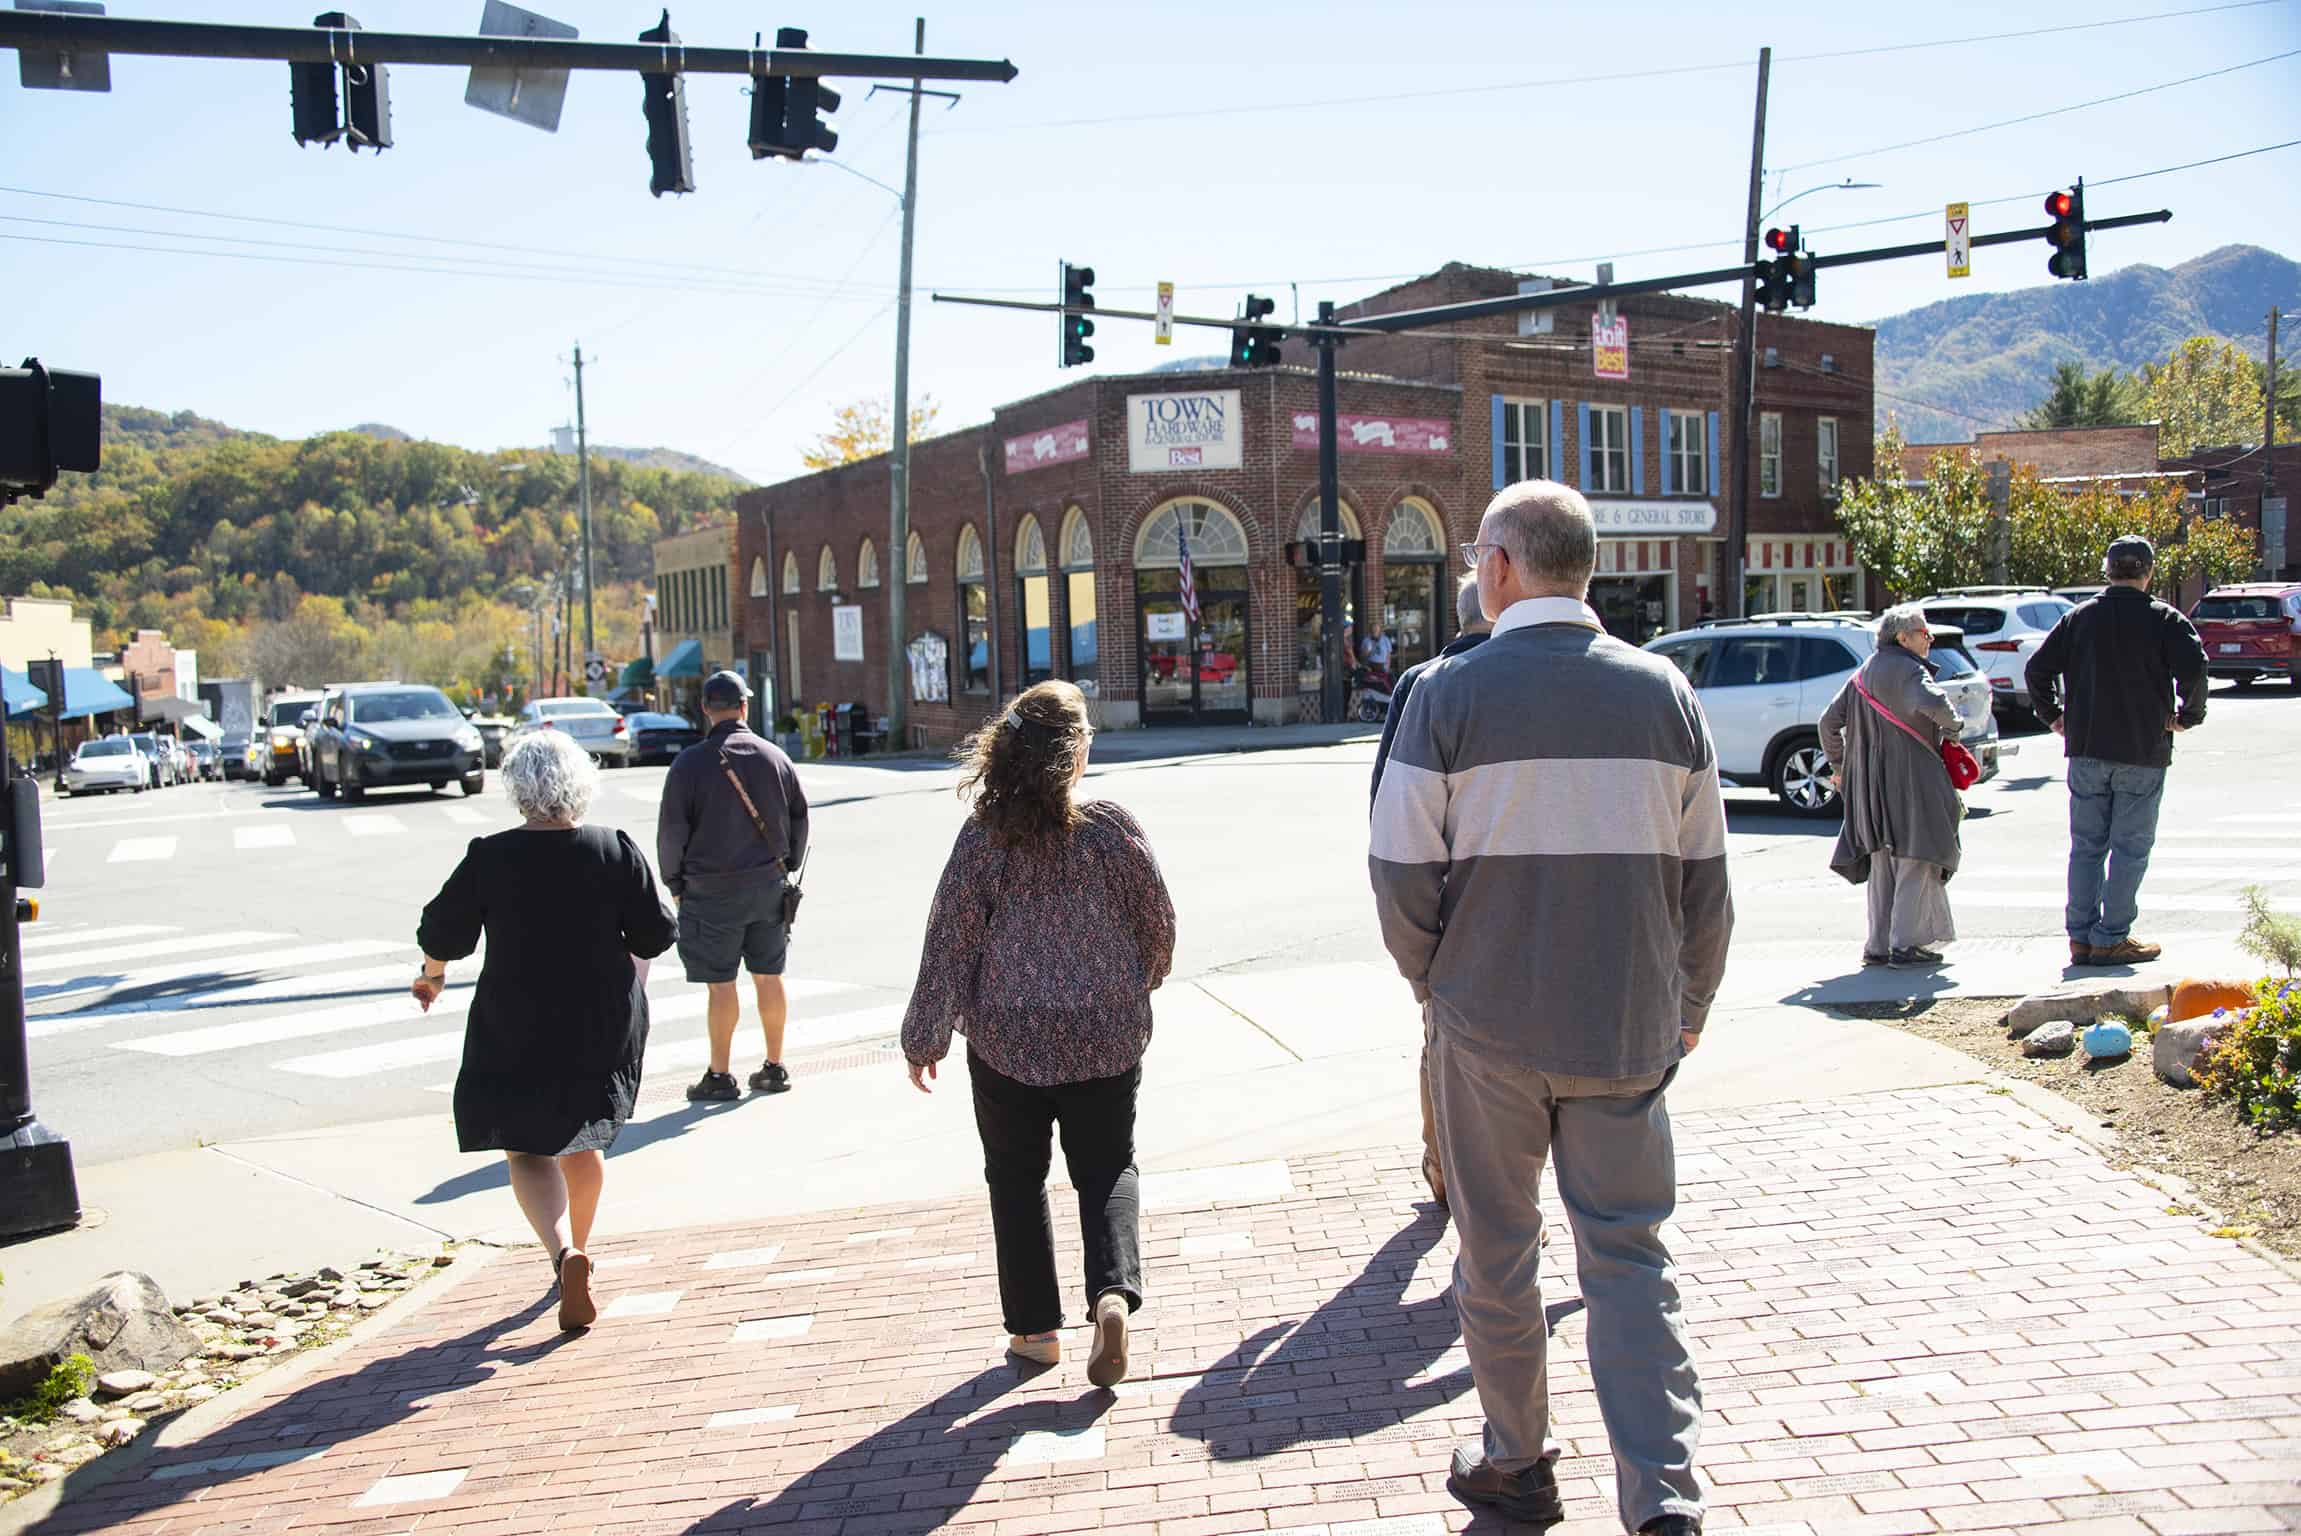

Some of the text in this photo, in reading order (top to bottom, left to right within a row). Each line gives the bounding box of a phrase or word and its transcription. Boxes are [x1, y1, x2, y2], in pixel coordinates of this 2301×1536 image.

[1141, 396, 1225, 423] TOWN
[1145, 419, 1225, 438] HARDWARE
[1171, 450, 1200, 464] Best
[1628, 508, 1670, 525] GENERAL
[1679, 508, 1706, 525] STORE
